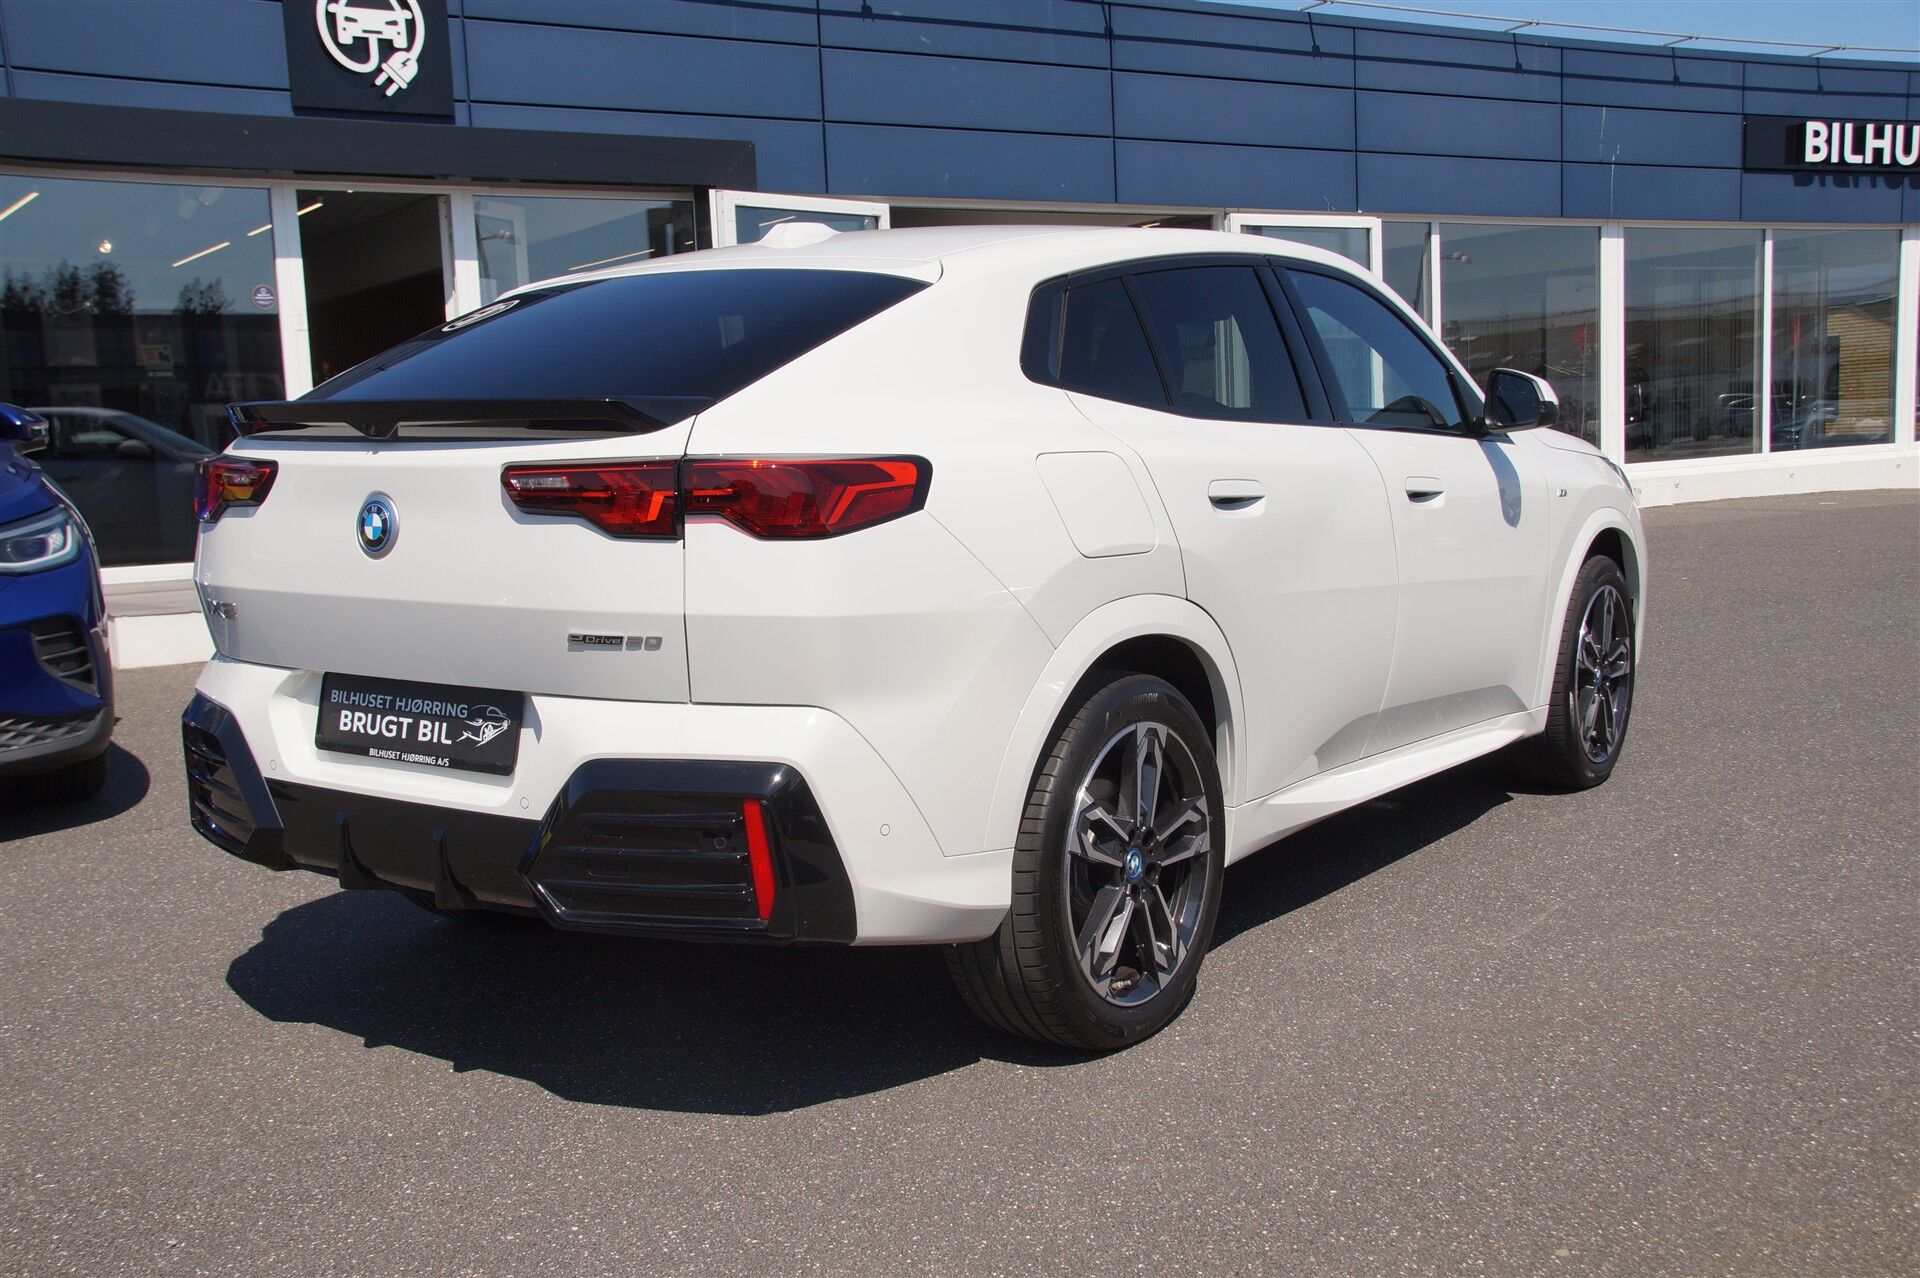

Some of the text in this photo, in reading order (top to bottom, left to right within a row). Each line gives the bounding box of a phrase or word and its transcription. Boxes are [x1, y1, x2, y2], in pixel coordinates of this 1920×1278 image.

[1804, 121, 1920, 166] BILHU
[330, 689, 468, 719] BILHUSET HJØRRING
[339, 710, 452, 744] BRUGT BIL
[369, 747, 450, 767] BILHUSET HJØRRING A/S
